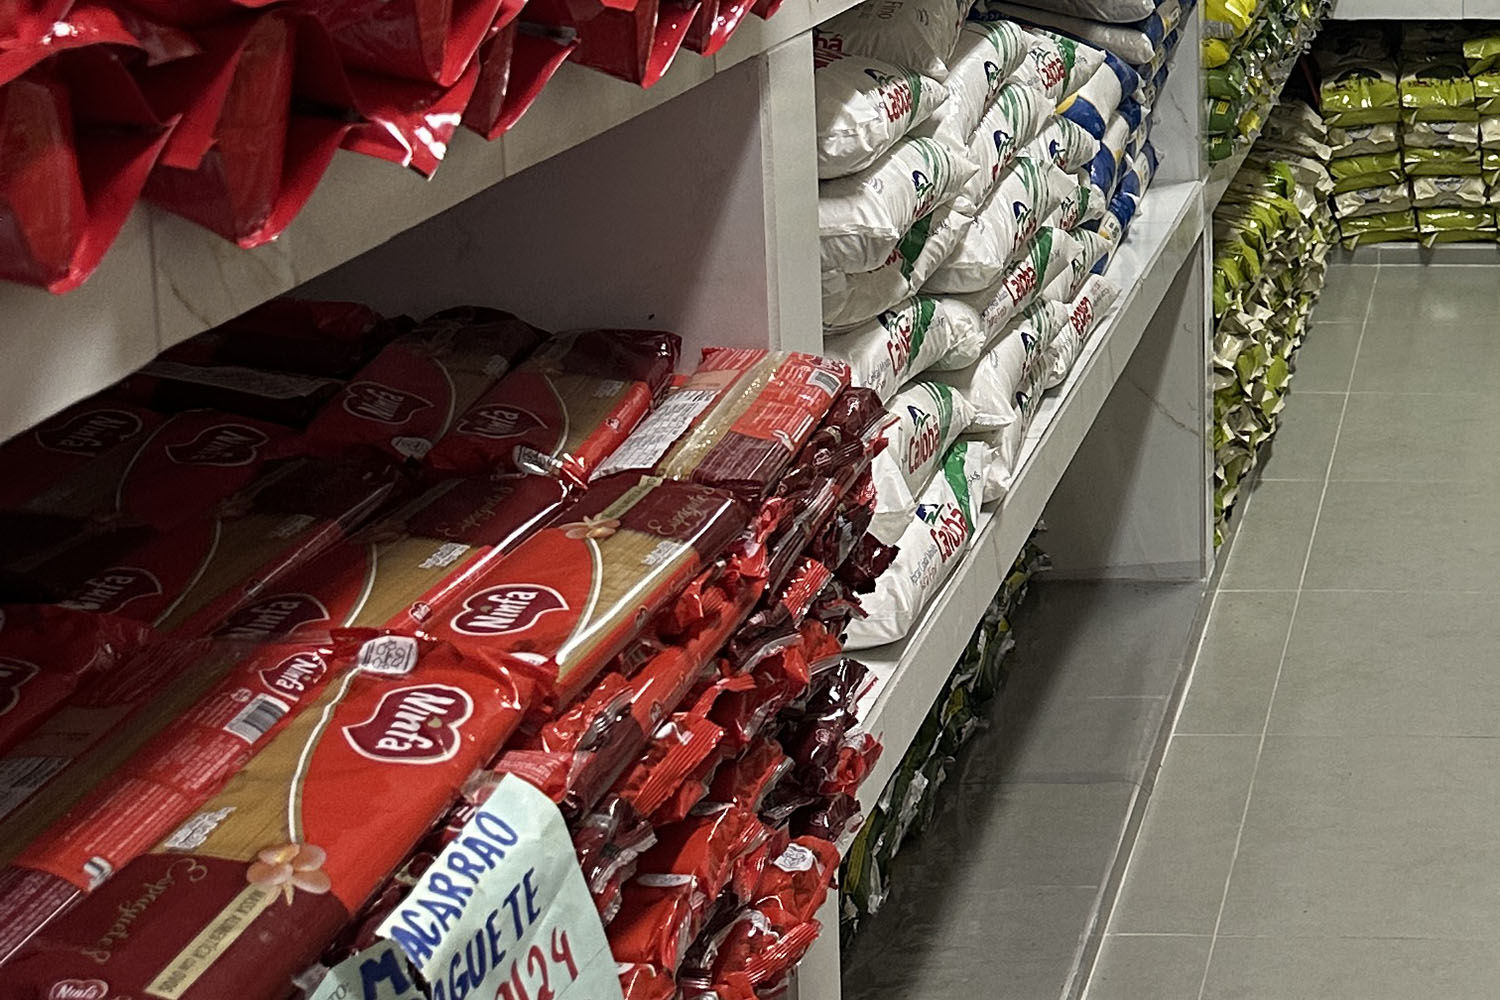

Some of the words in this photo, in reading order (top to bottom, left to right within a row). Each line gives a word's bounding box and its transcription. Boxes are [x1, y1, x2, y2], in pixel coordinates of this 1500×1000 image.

[909, 416, 941, 474] Caiobá
[929, 502, 969, 564] Caiobá
[467, 589, 539, 630] Ninfa
[375, 690, 457, 752] Ninfa
